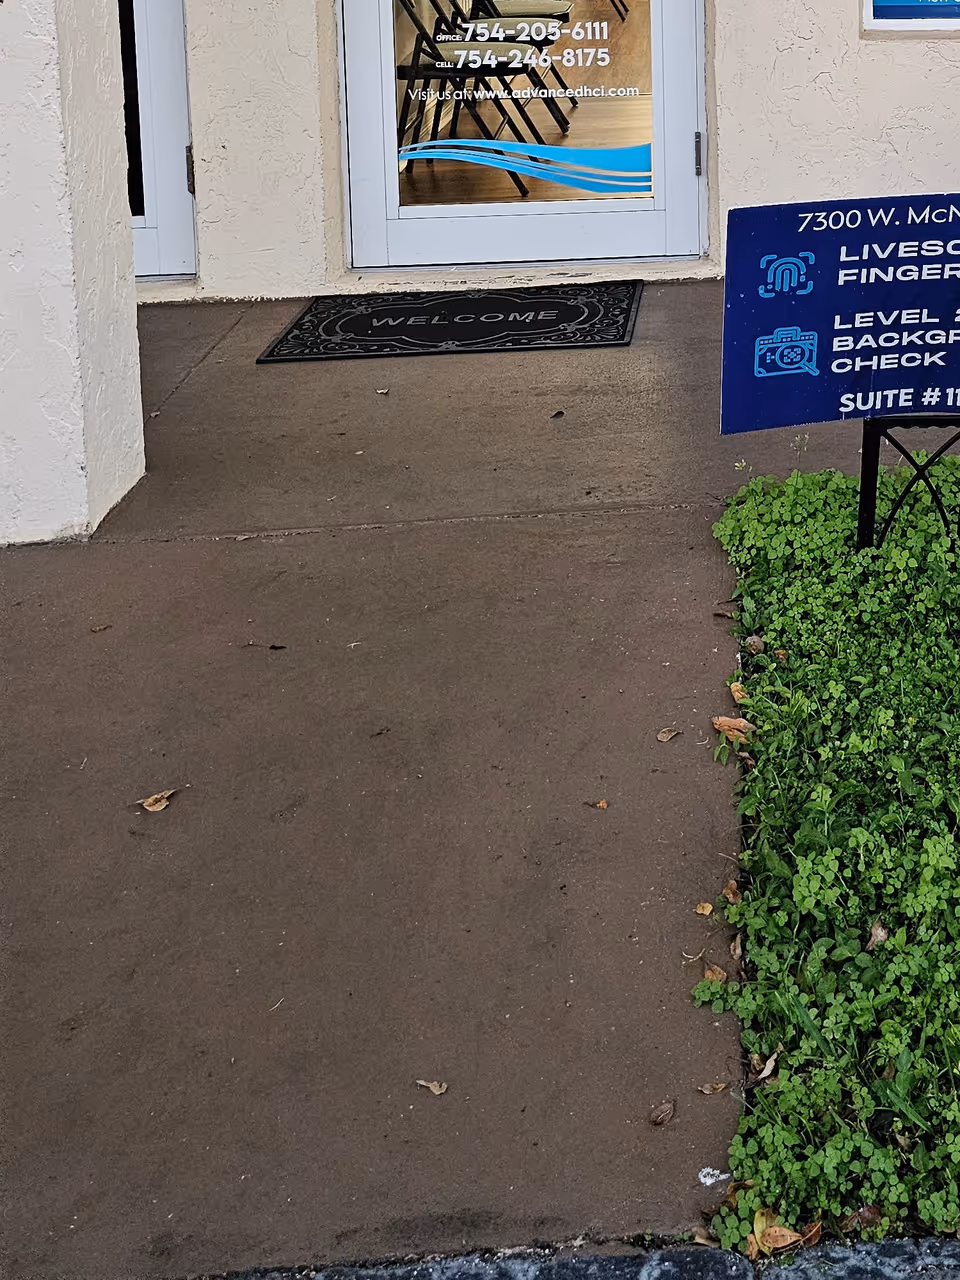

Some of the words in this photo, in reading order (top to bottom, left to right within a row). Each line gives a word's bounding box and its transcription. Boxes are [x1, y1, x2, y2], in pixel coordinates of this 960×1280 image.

[462, 21, 609, 42] 754-205-6111
[454, 48, 611, 69] 754-246-8175
[407, 89, 435, 101] Visit
[473, 85, 640, 100] www.advancedhci.com
[797, 209, 861, 233] 7300
[867, 207, 900, 227] W.
[371, 310, 559, 327] WELCOME
[834, 308, 940, 330] LEVEL
[831, 351, 947, 374] CHECK
[839, 388, 915, 413] SUITE
